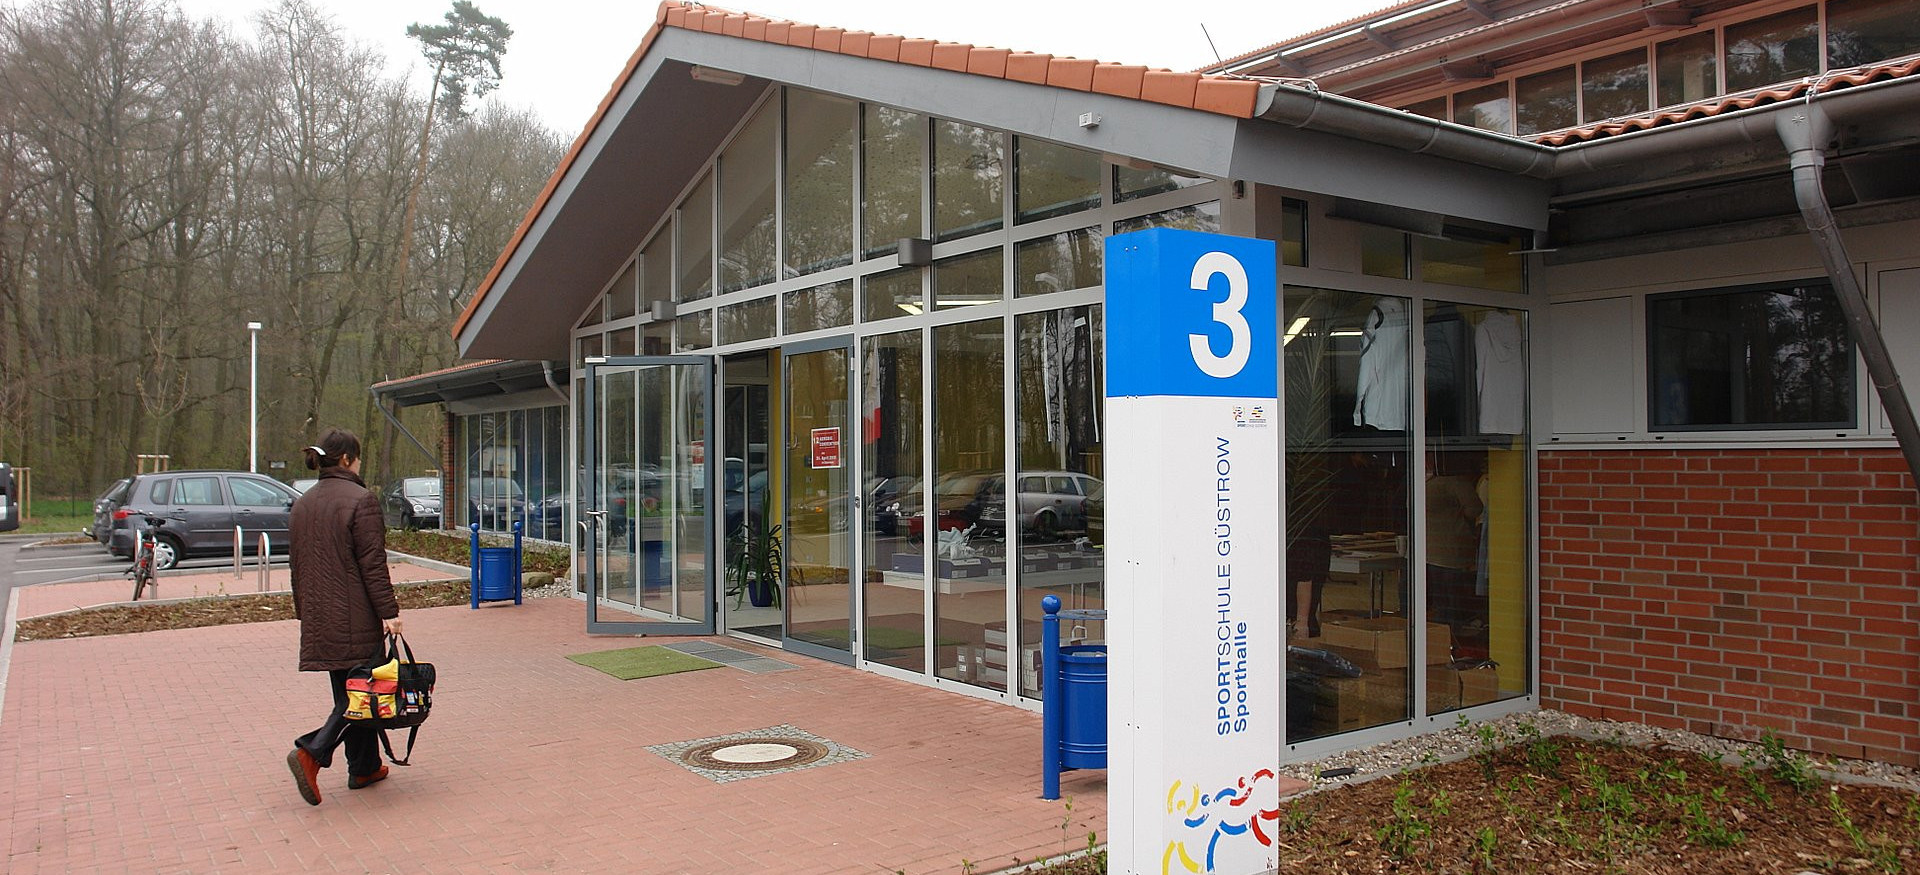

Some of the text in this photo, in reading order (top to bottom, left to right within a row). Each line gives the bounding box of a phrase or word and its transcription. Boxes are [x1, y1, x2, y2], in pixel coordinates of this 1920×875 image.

[1188, 251, 1252, 379] 3
[1214, 436, 1231, 736] SPORTSCHULE GÜSTROW
[1234, 621, 1250, 733] Sporthalle
